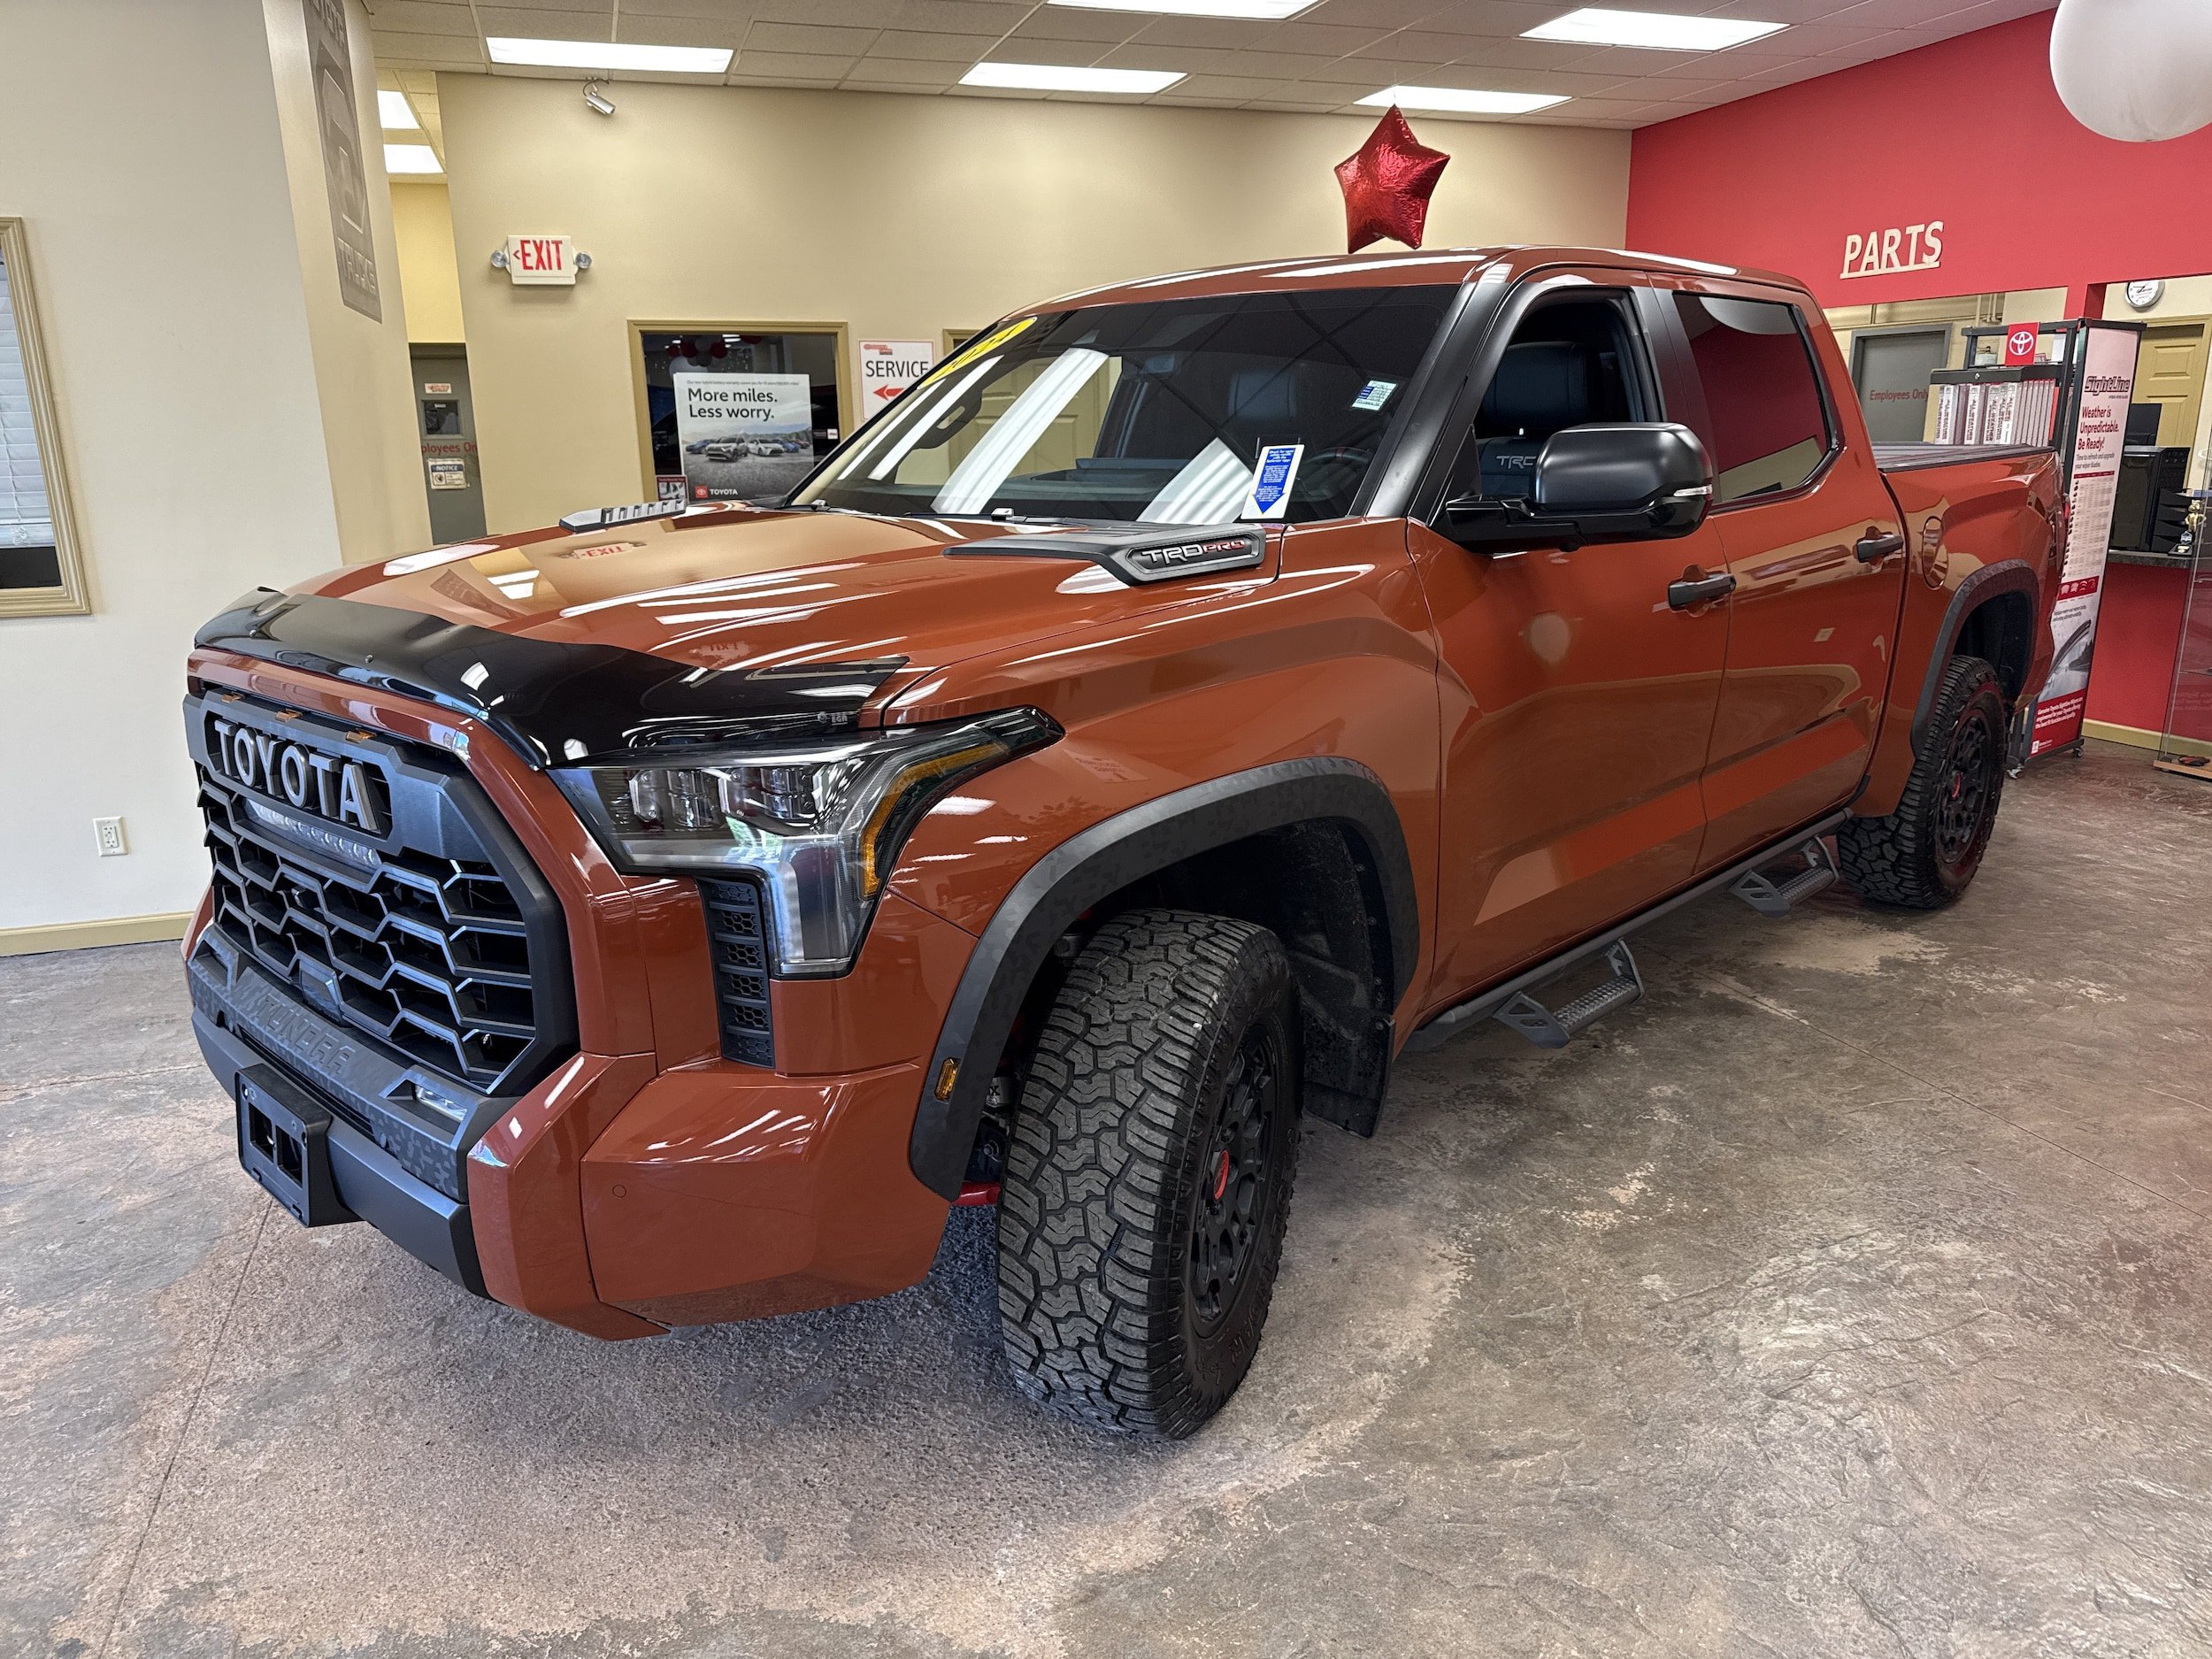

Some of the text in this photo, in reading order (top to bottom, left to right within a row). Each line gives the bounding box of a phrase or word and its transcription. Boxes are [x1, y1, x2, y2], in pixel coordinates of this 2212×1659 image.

[519, 239, 563, 271] EXIT
[1842, 220, 1944, 275] PARTS
[337, 236, 377, 295] TRUCKS
[2084, 375, 2131, 396] SightLine
[688, 388, 778, 403] More miles.
[1870, 389, 1910, 403] Employees
[688, 404, 774, 422] Less worry.
[2082, 405, 2111, 419] Weather is
[2080, 420, 2119, 437] Unpredictable.
[421, 442, 477, 456] ployees On
[2078, 436, 2105, 452] Be Ready!
[1141, 540, 1247, 565] TRD PRO
[214, 718, 380, 832] TOYOTA
[255, 992, 357, 1076] TUNDRA
